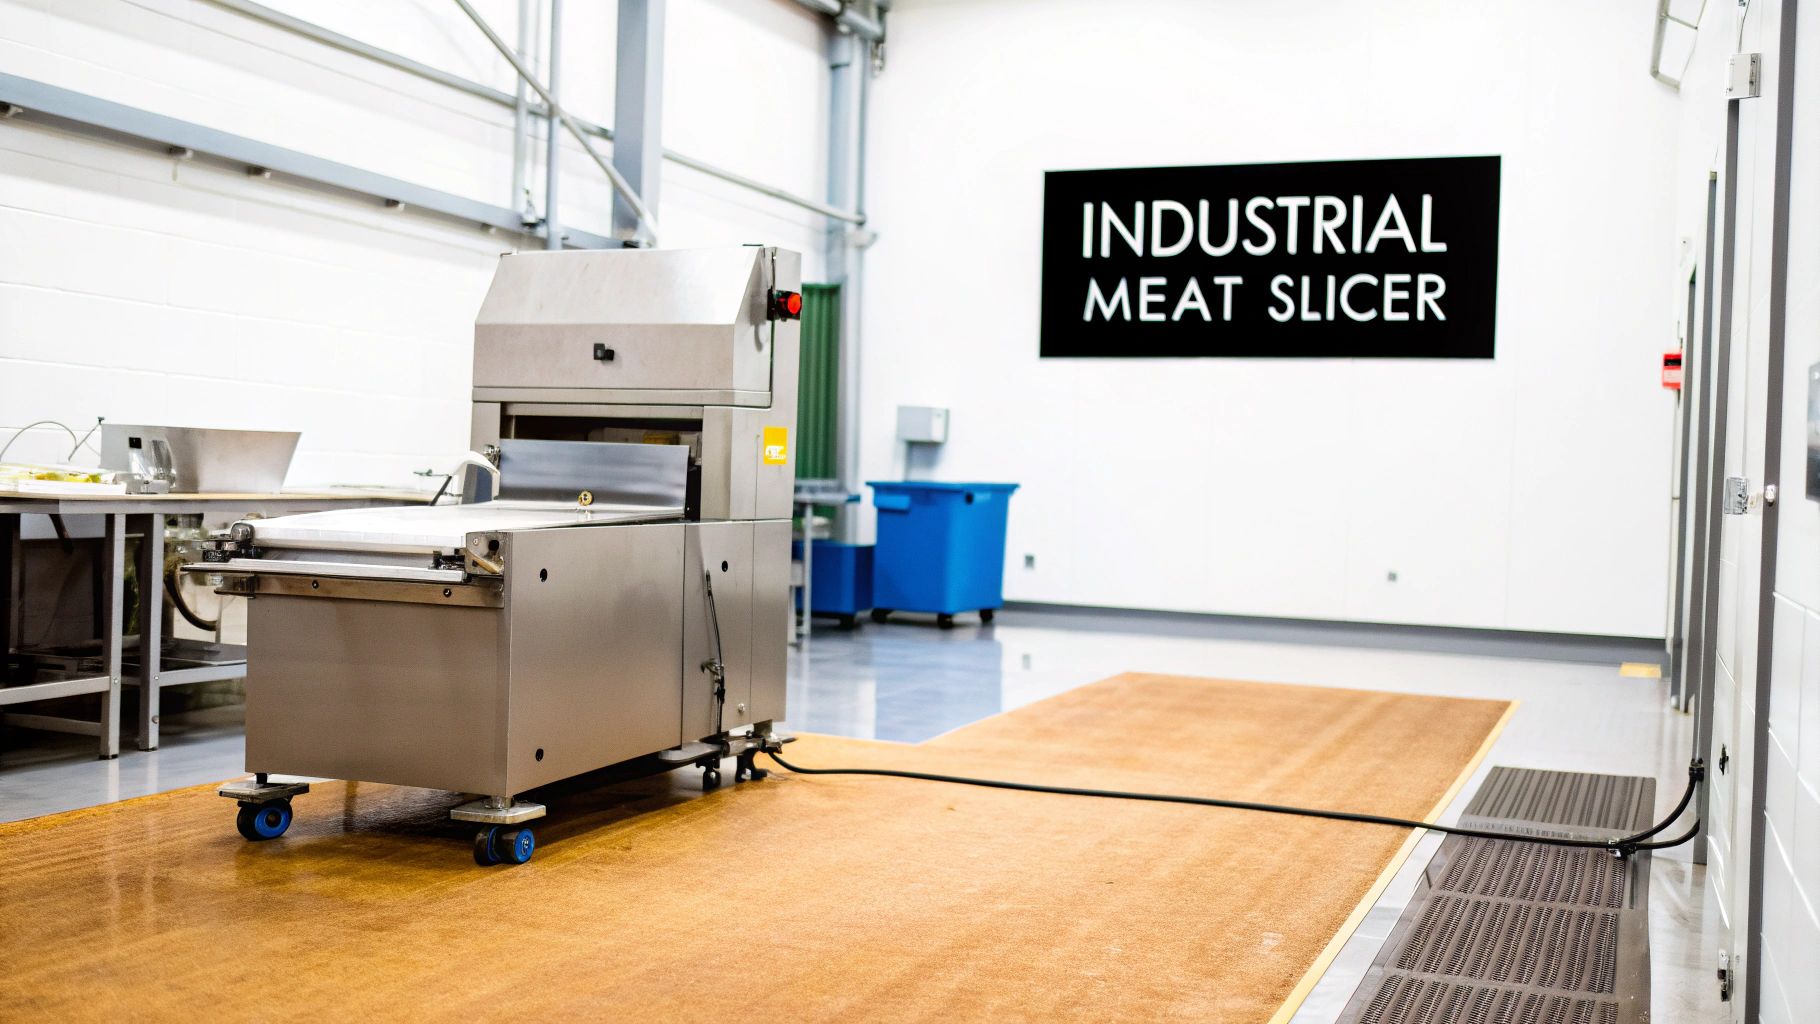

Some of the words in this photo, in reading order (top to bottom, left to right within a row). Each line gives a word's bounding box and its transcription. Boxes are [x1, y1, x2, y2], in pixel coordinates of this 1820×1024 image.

[1082, 194, 1448, 258] INDUSTRIAL
[1083, 275, 1243, 322] MEAT
[1267, 273, 1447, 323] SLICER
